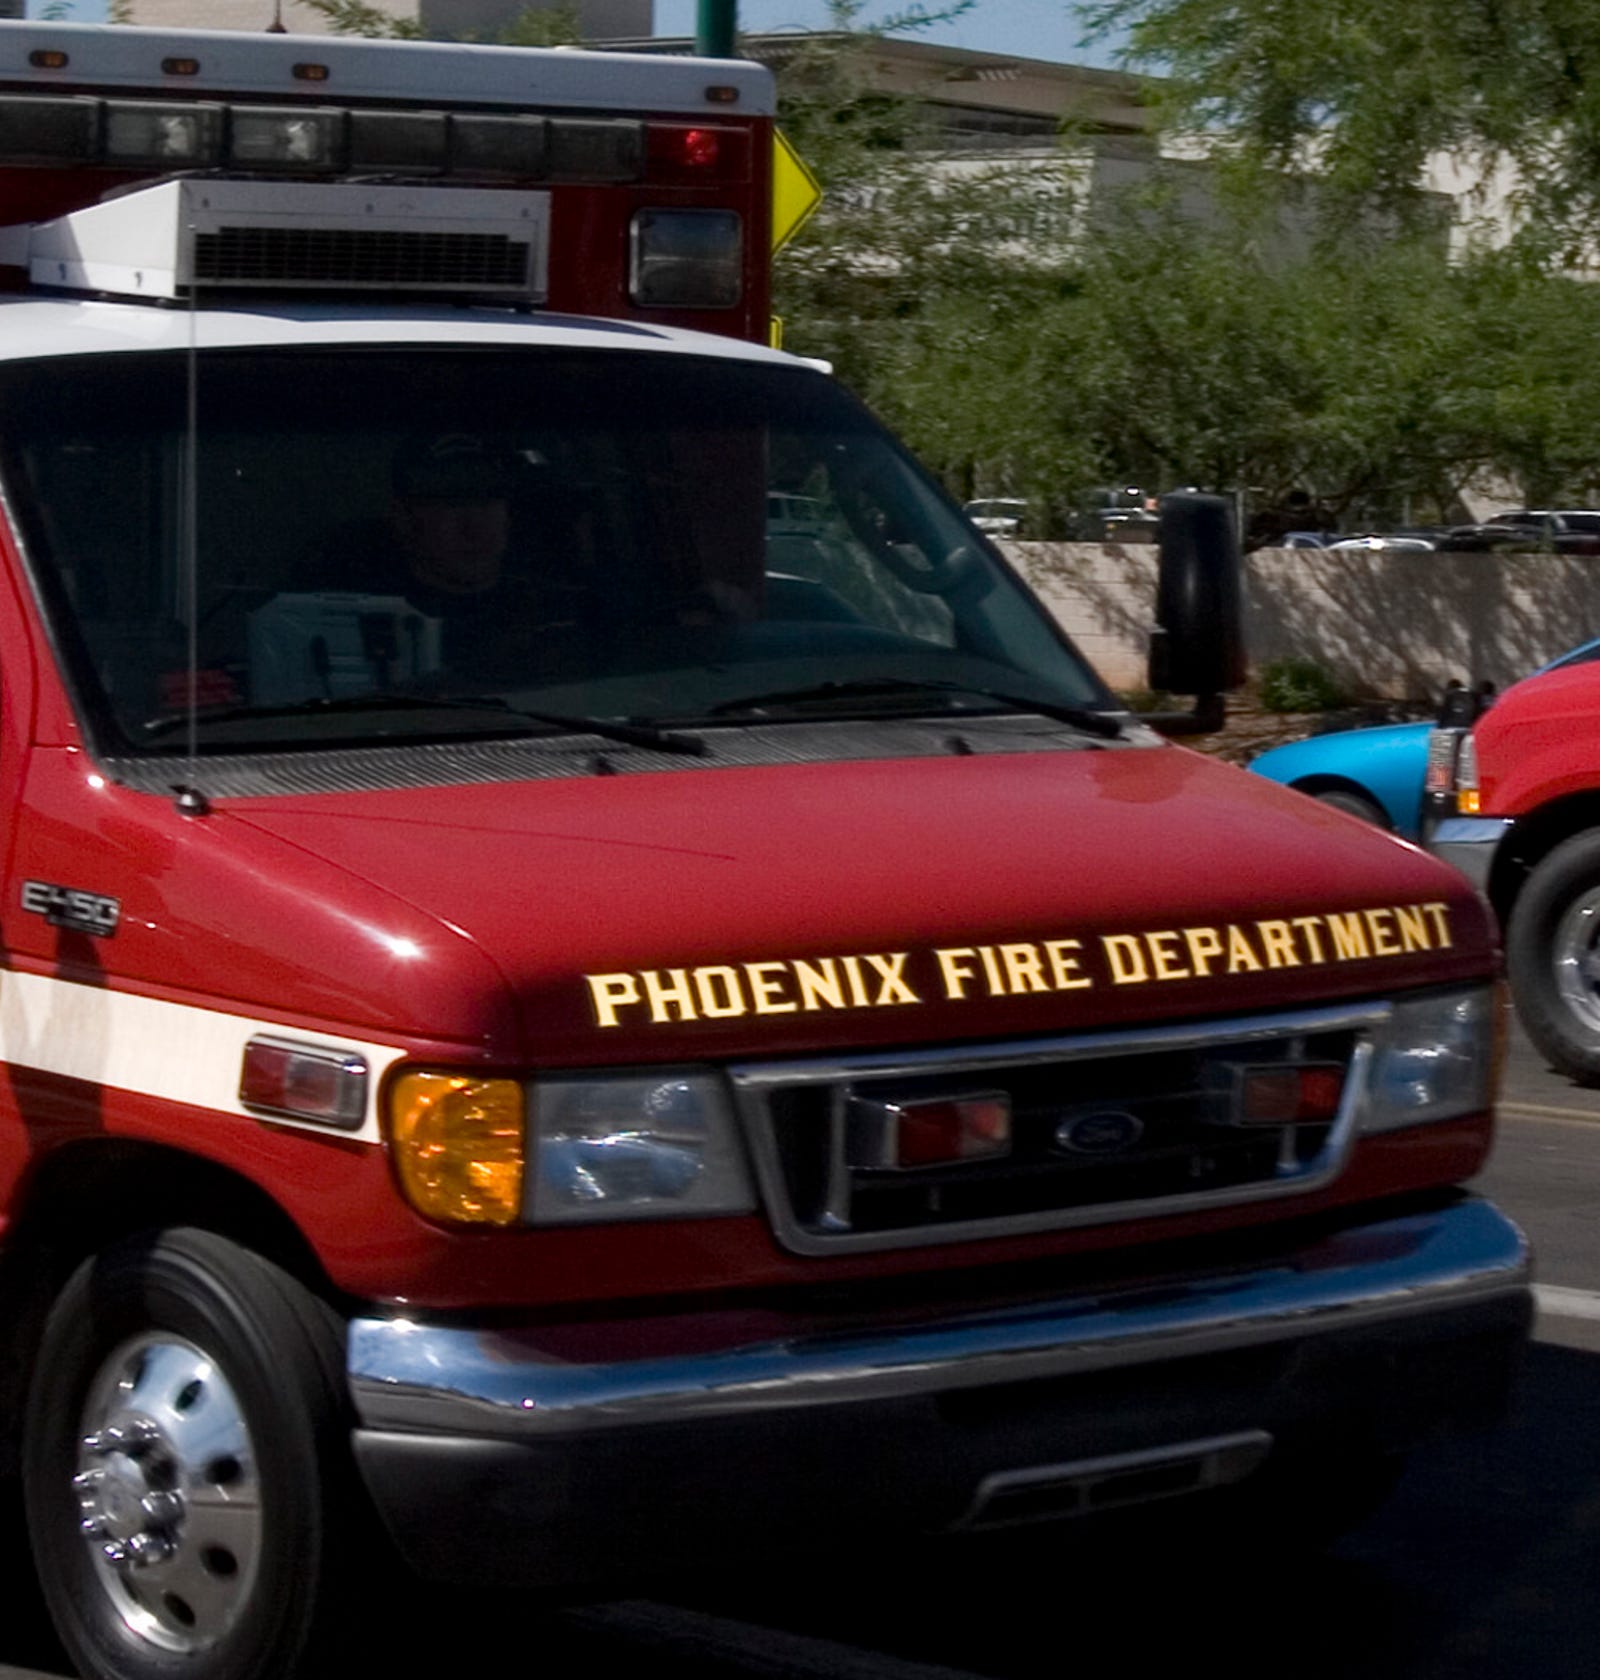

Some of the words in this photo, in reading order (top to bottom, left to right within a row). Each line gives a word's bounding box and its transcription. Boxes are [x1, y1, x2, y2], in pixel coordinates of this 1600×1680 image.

[585, 953, 923, 1027] PHOENIX
[935, 940, 1093, 999] FIRE
[1100, 903, 1453, 985] DEPARTMENT
